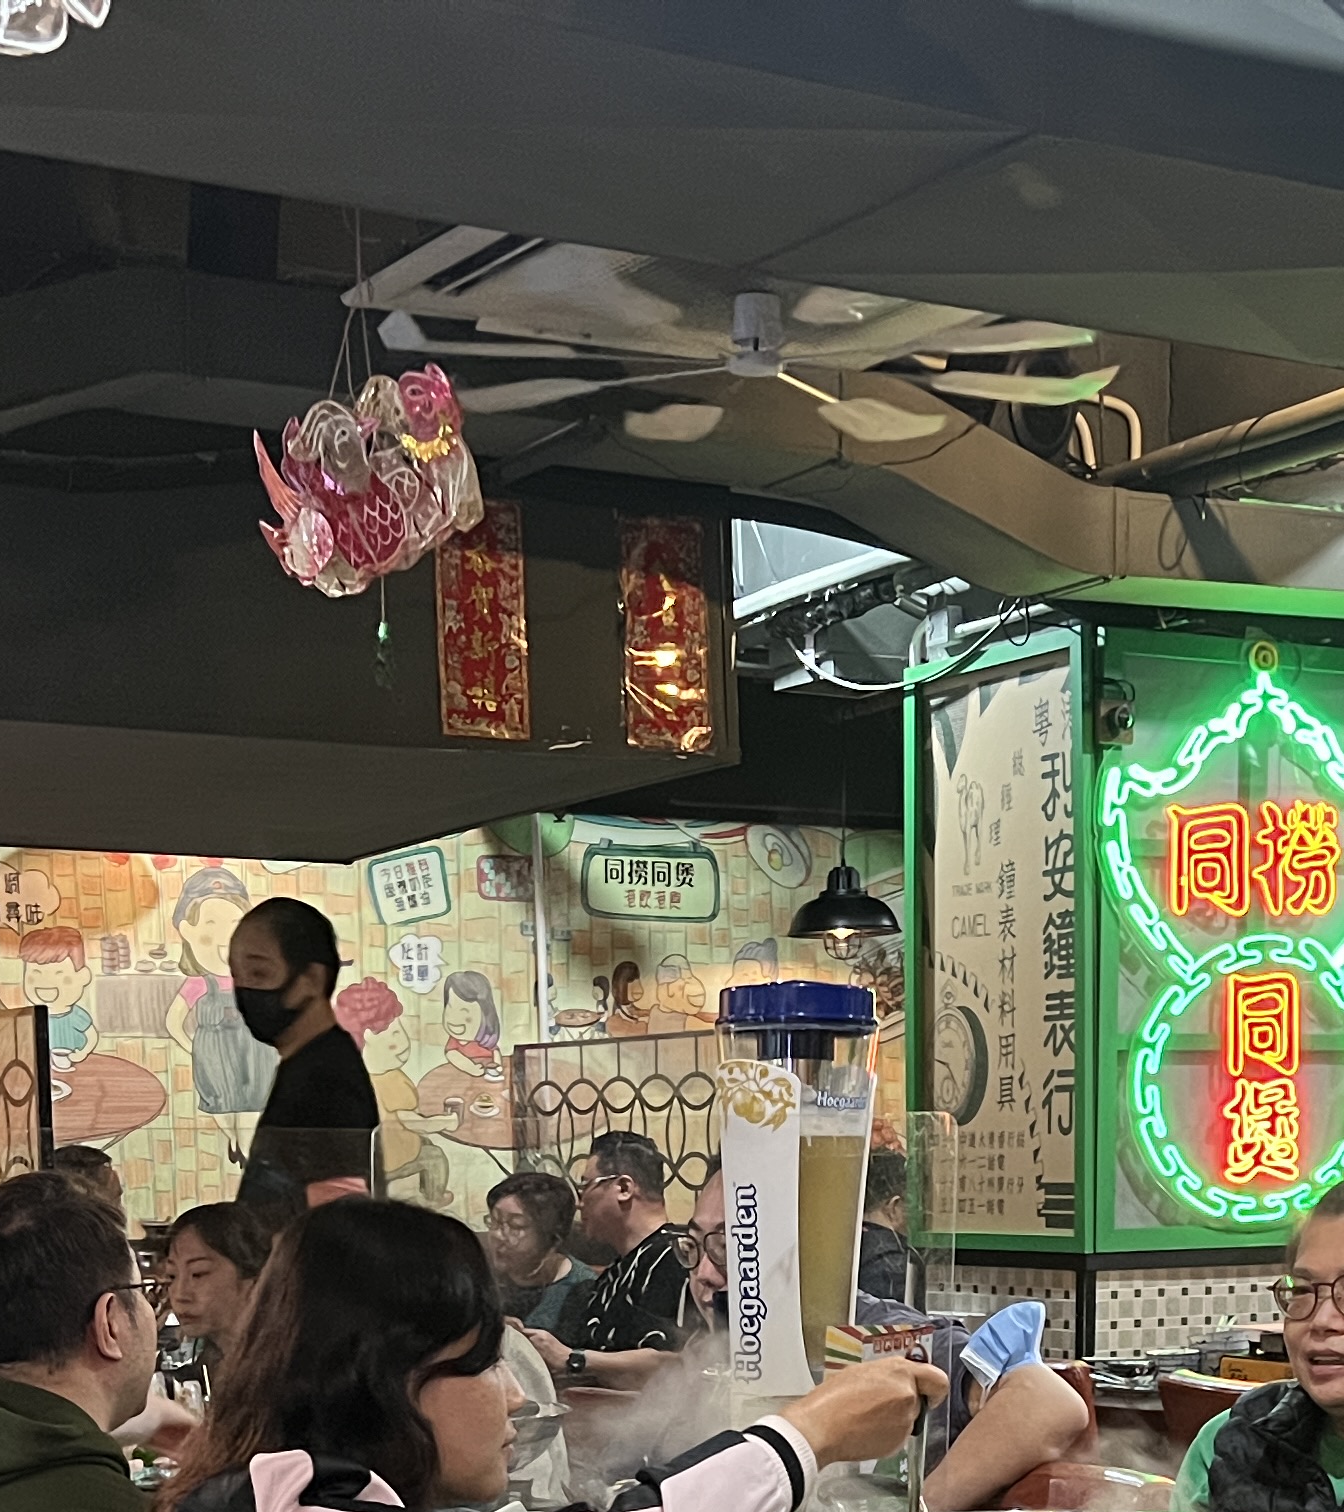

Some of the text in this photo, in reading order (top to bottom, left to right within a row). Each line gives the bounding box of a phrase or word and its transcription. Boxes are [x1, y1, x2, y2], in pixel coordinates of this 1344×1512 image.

[604, 858, 694, 887] 同撈同煲
[1166, 800, 1340, 916] 同撈
[951, 913, 992, 940] CAMEL
[1223, 973, 1299, 1185] 同煲
[732, 1183, 767, 1384] Hoegaarden
